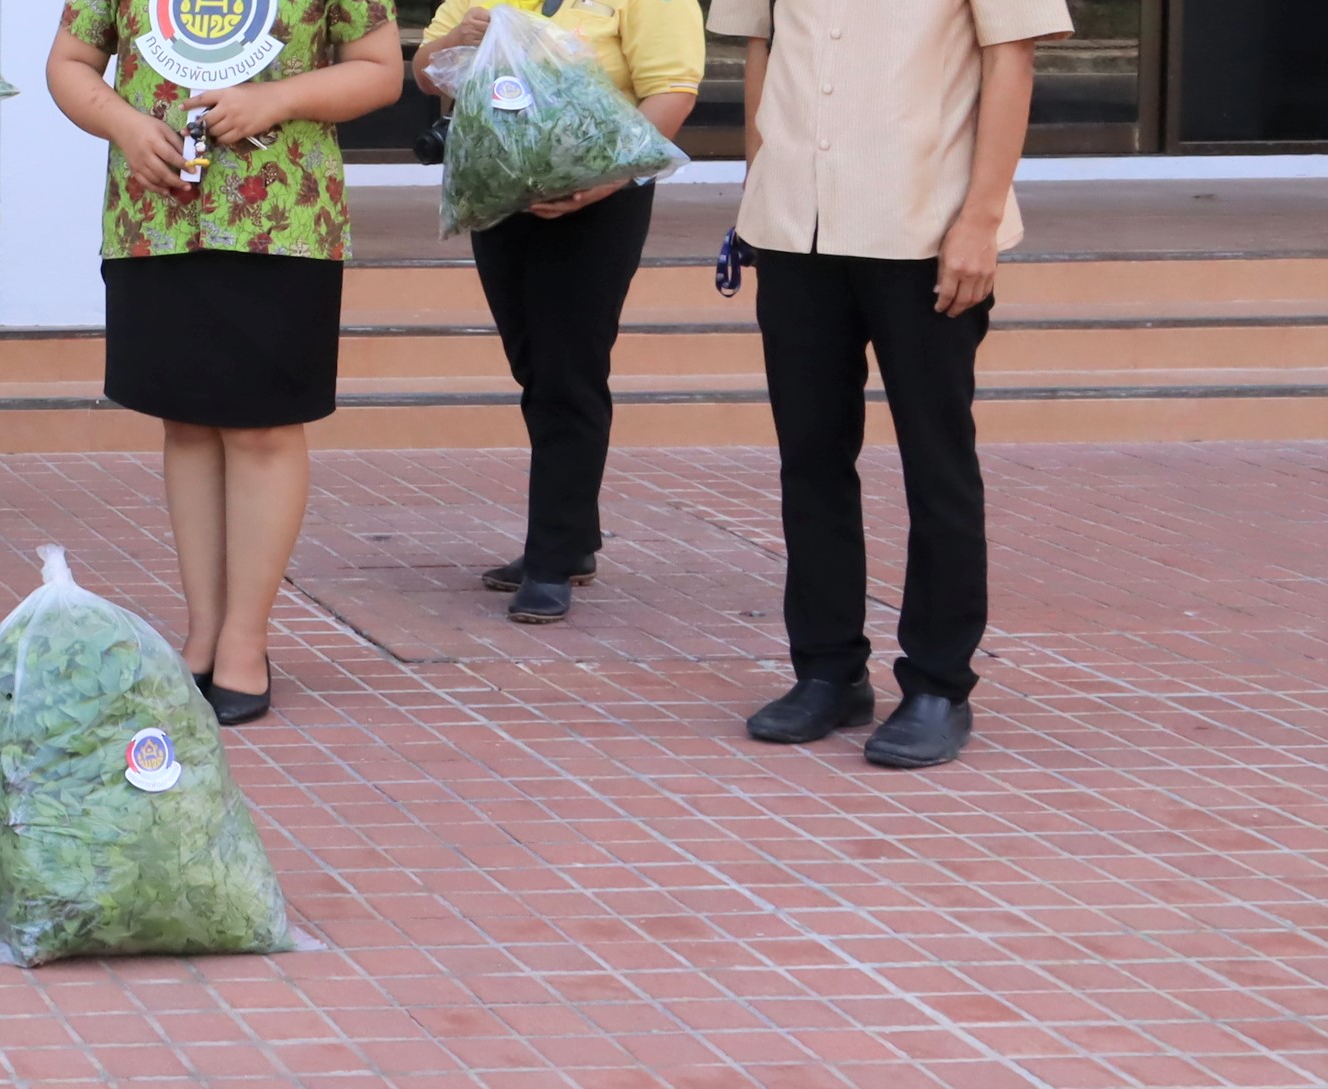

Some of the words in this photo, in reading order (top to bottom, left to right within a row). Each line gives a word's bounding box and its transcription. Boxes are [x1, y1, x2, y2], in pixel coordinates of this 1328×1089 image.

[145, 35, 273, 82] กรมการพัฒนาชุมชน
